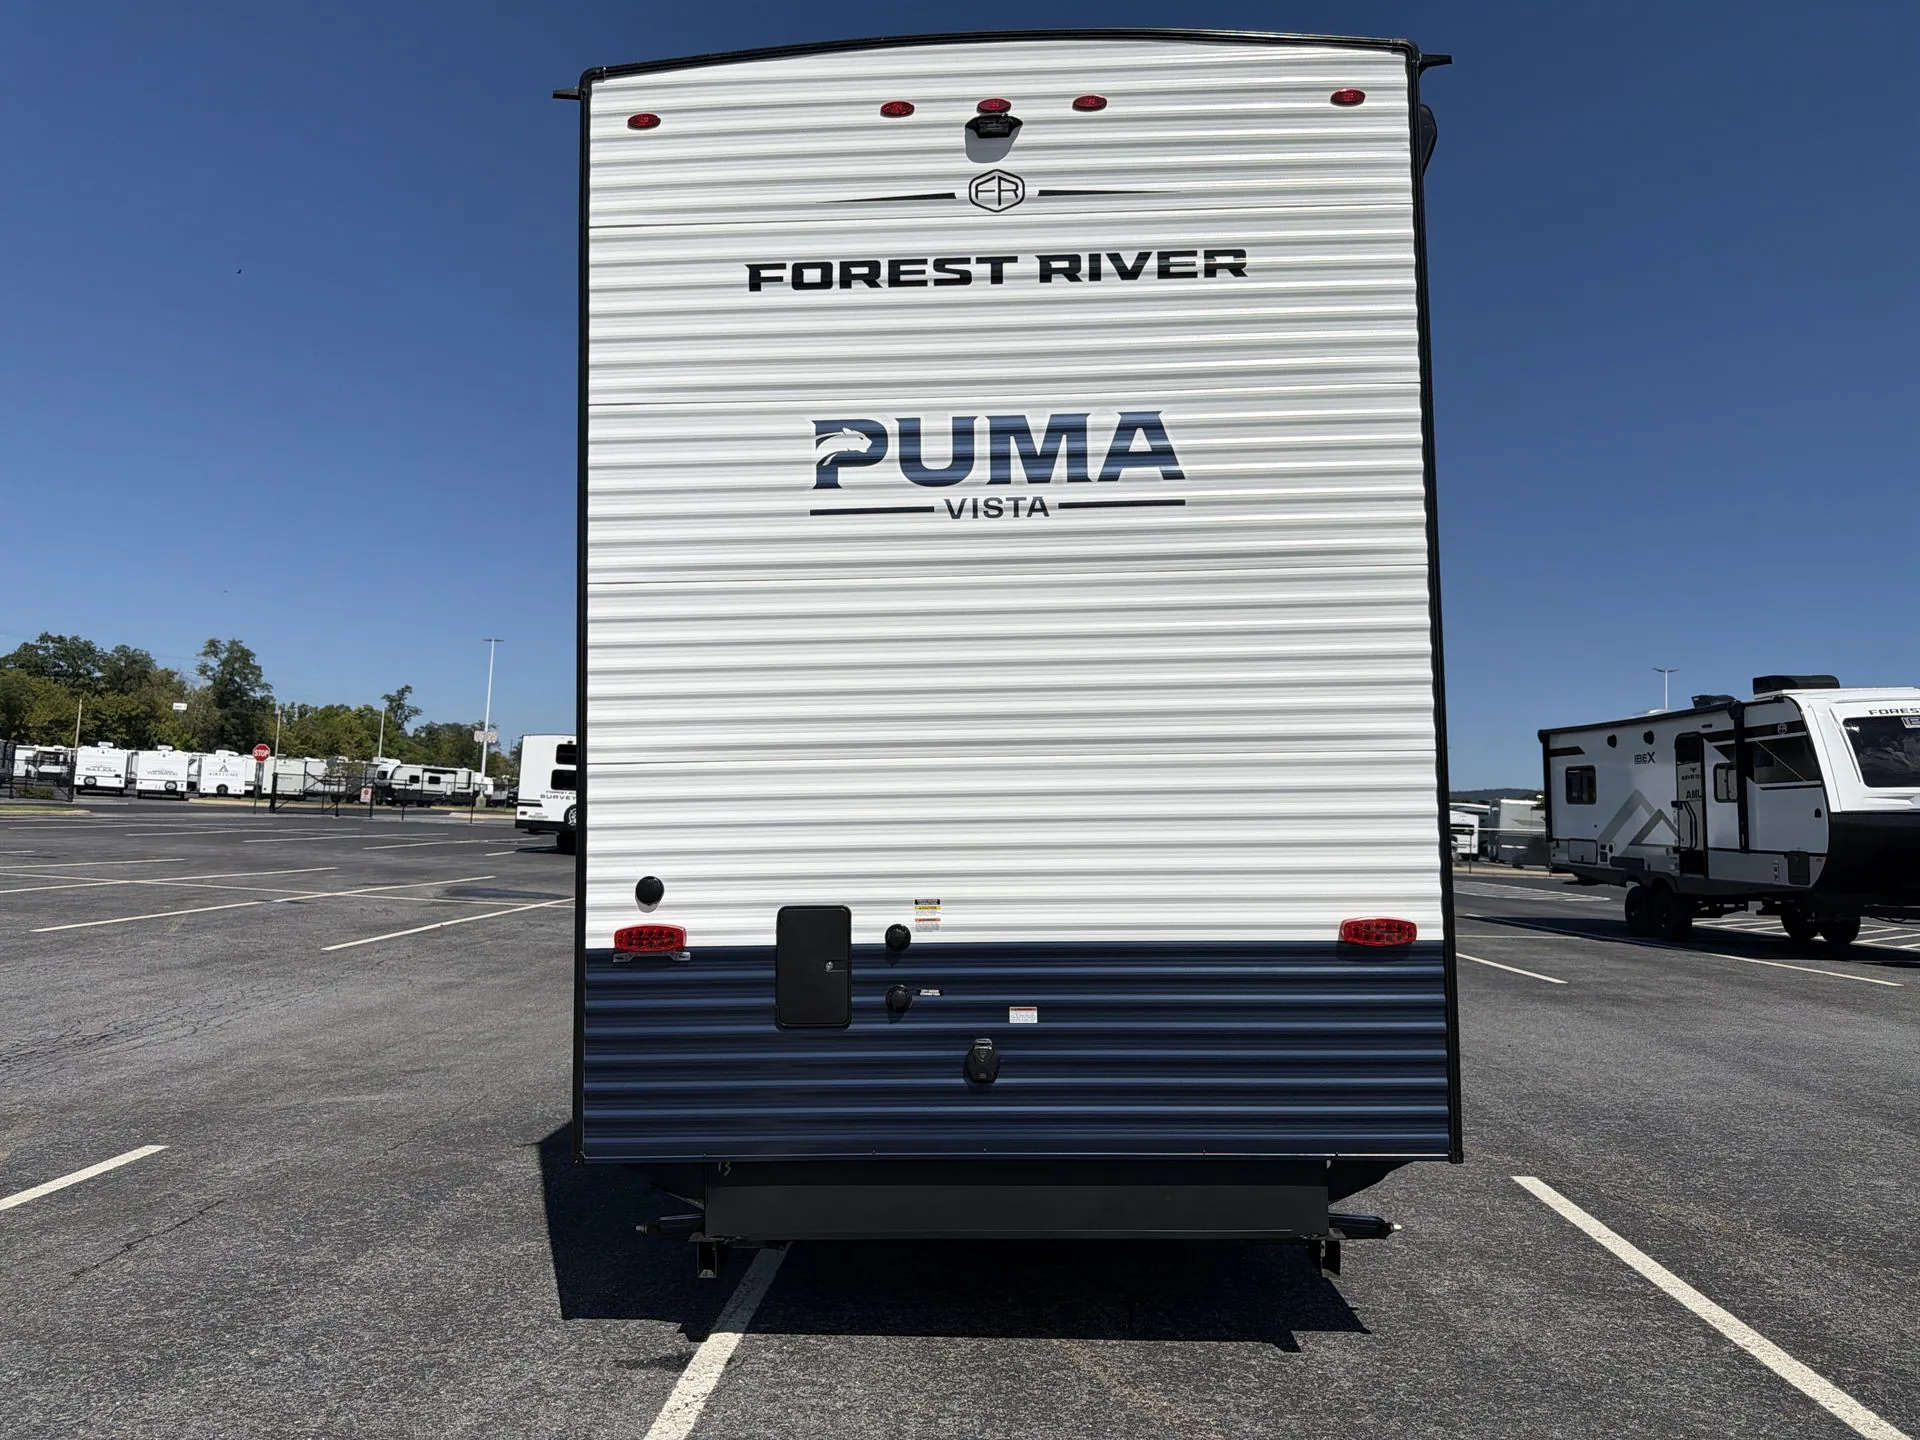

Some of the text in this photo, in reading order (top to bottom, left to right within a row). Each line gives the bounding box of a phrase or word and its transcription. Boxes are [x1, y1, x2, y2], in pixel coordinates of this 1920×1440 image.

[745, 248, 1249, 292] FOREST RIVER
[811, 410, 1186, 490] PUMA
[944, 496, 1051, 520] VISTA
[1868, 707, 1920, 716] FORES
[254, 749, 269, 758] STOP
[1634, 751, 1656, 765] IBEX
